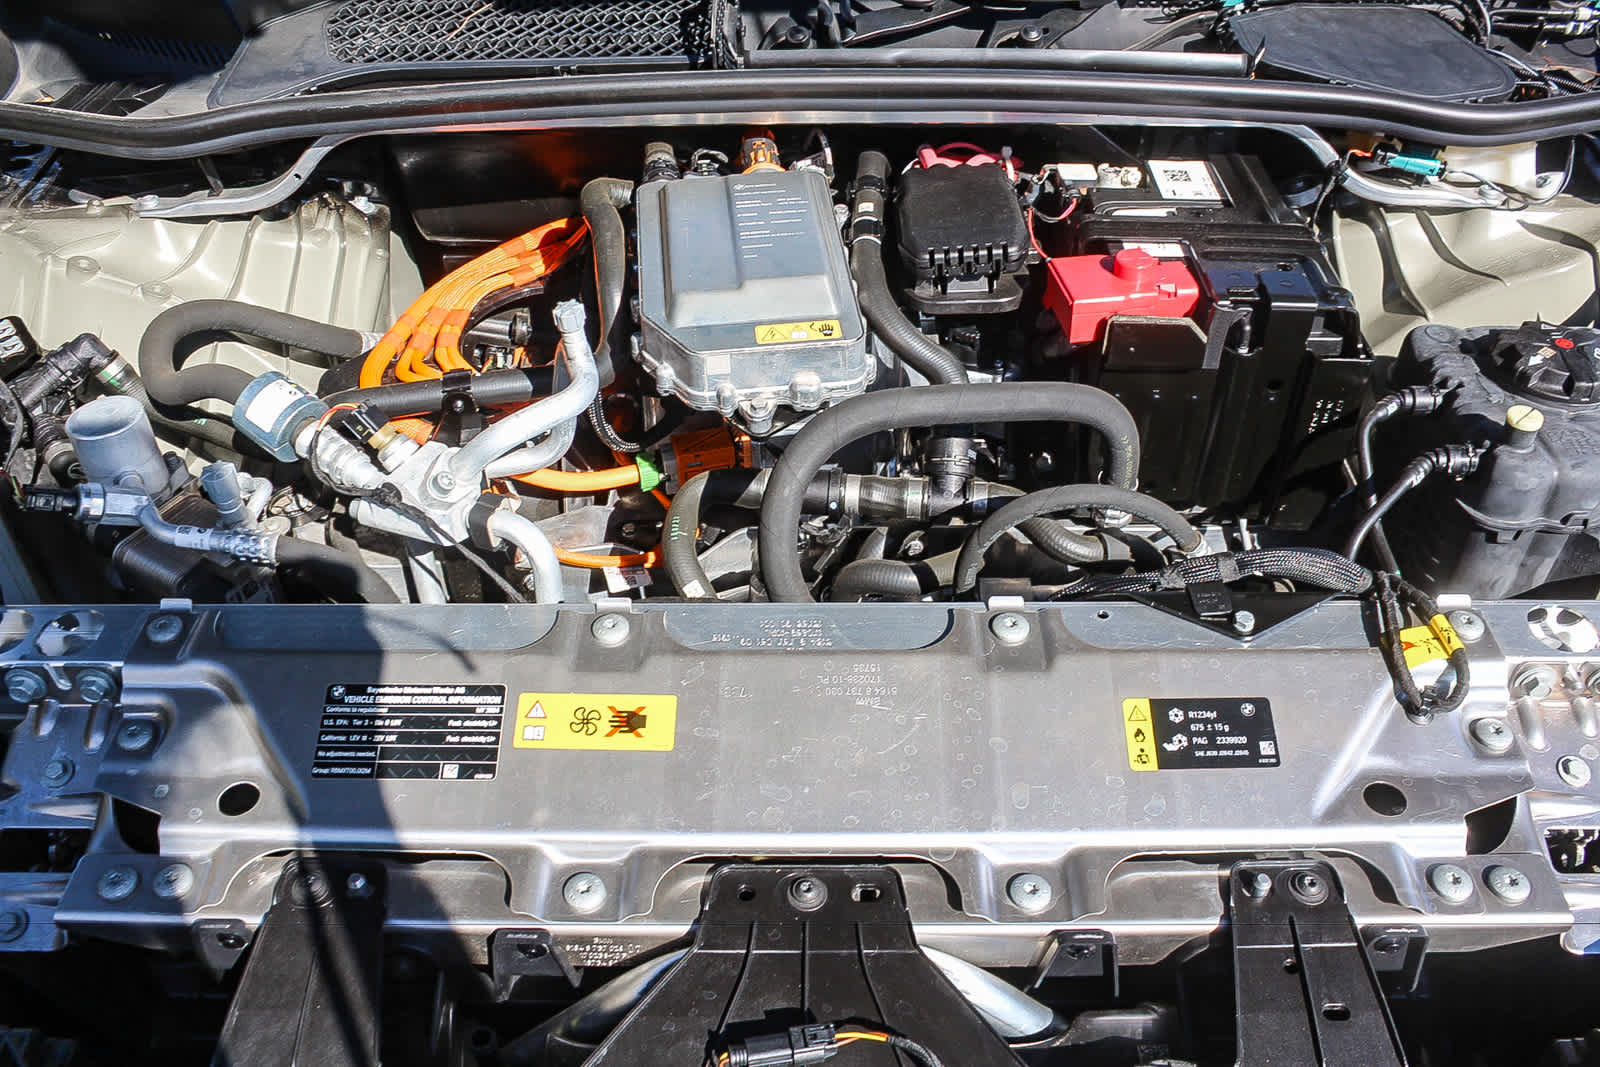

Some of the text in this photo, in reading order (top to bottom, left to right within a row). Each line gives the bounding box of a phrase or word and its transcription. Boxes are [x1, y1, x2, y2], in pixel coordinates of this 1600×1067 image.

[344, 696, 374, 704] VEHICLE
[412, 696, 448, 704] CONTROL
[1188, 710, 1217, 720] R1234yf
[1190, 723, 1205, 731] 675
[1214, 723, 1223, 731] 15
[1192, 736, 1208, 744] PAG
